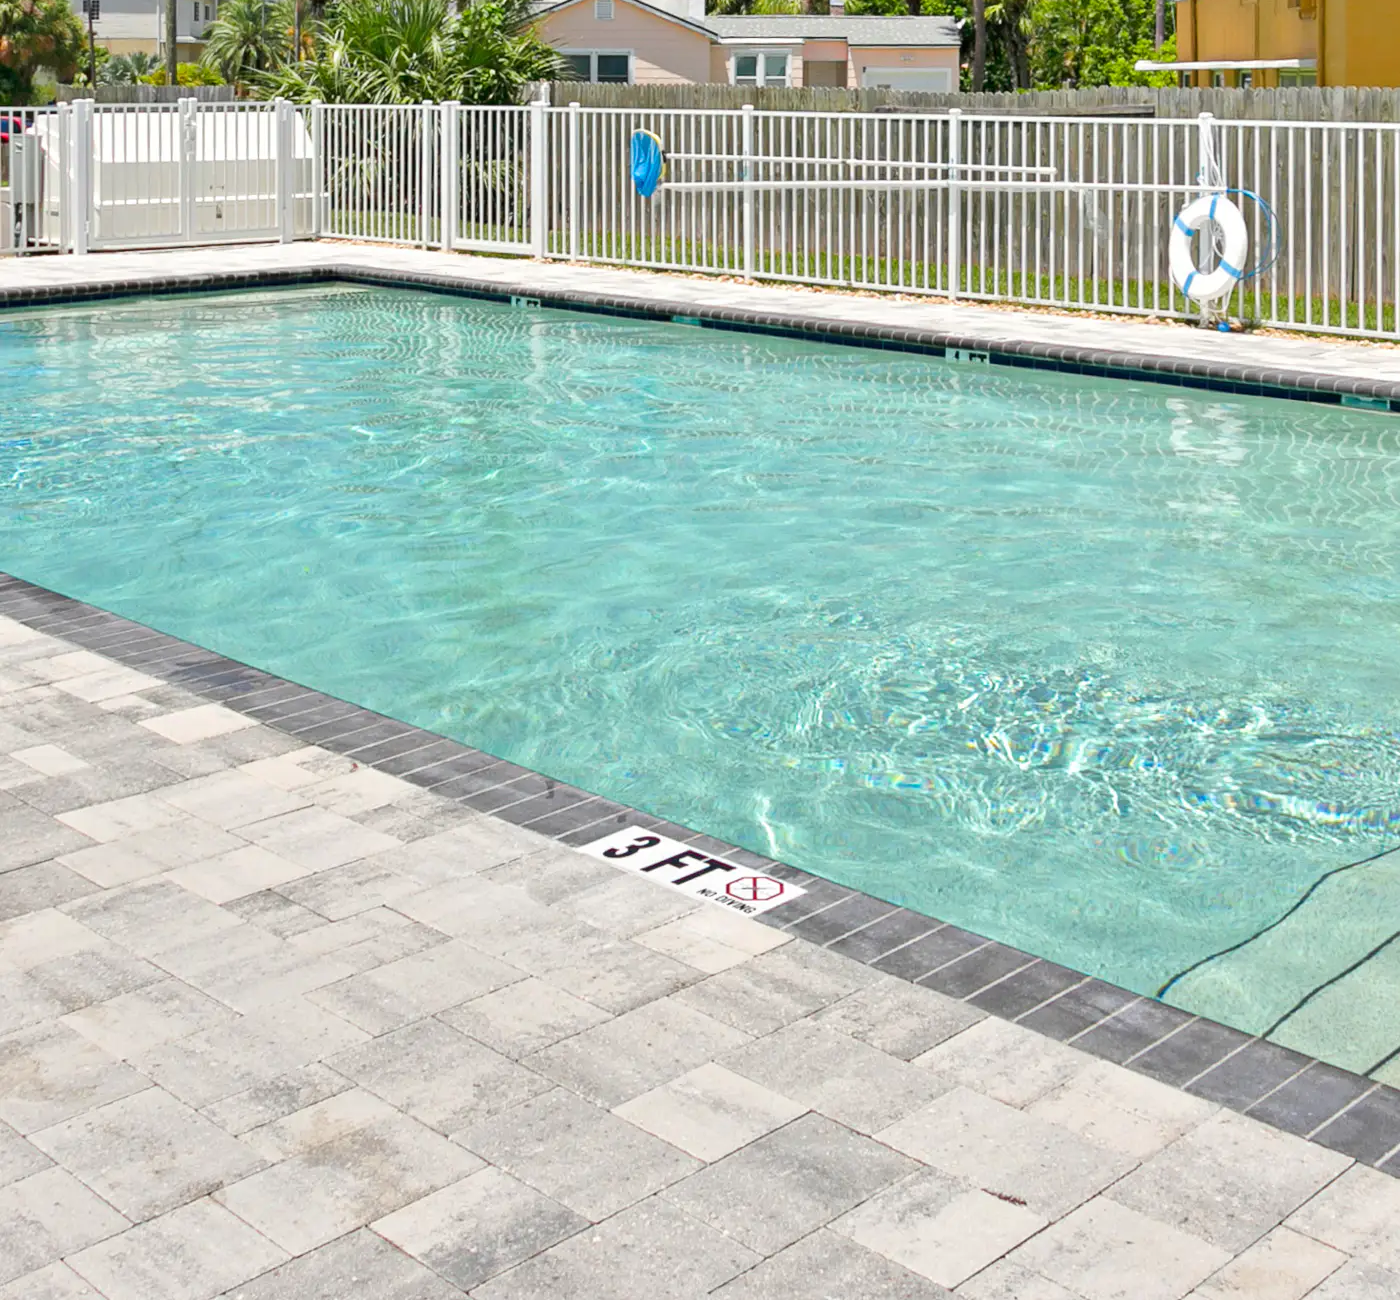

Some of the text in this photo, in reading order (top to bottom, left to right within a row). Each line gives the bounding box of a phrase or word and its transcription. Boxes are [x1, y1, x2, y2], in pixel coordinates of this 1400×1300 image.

[603, 835, 736, 885] 3 FT
[696, 887, 757, 914] NO DIVING
